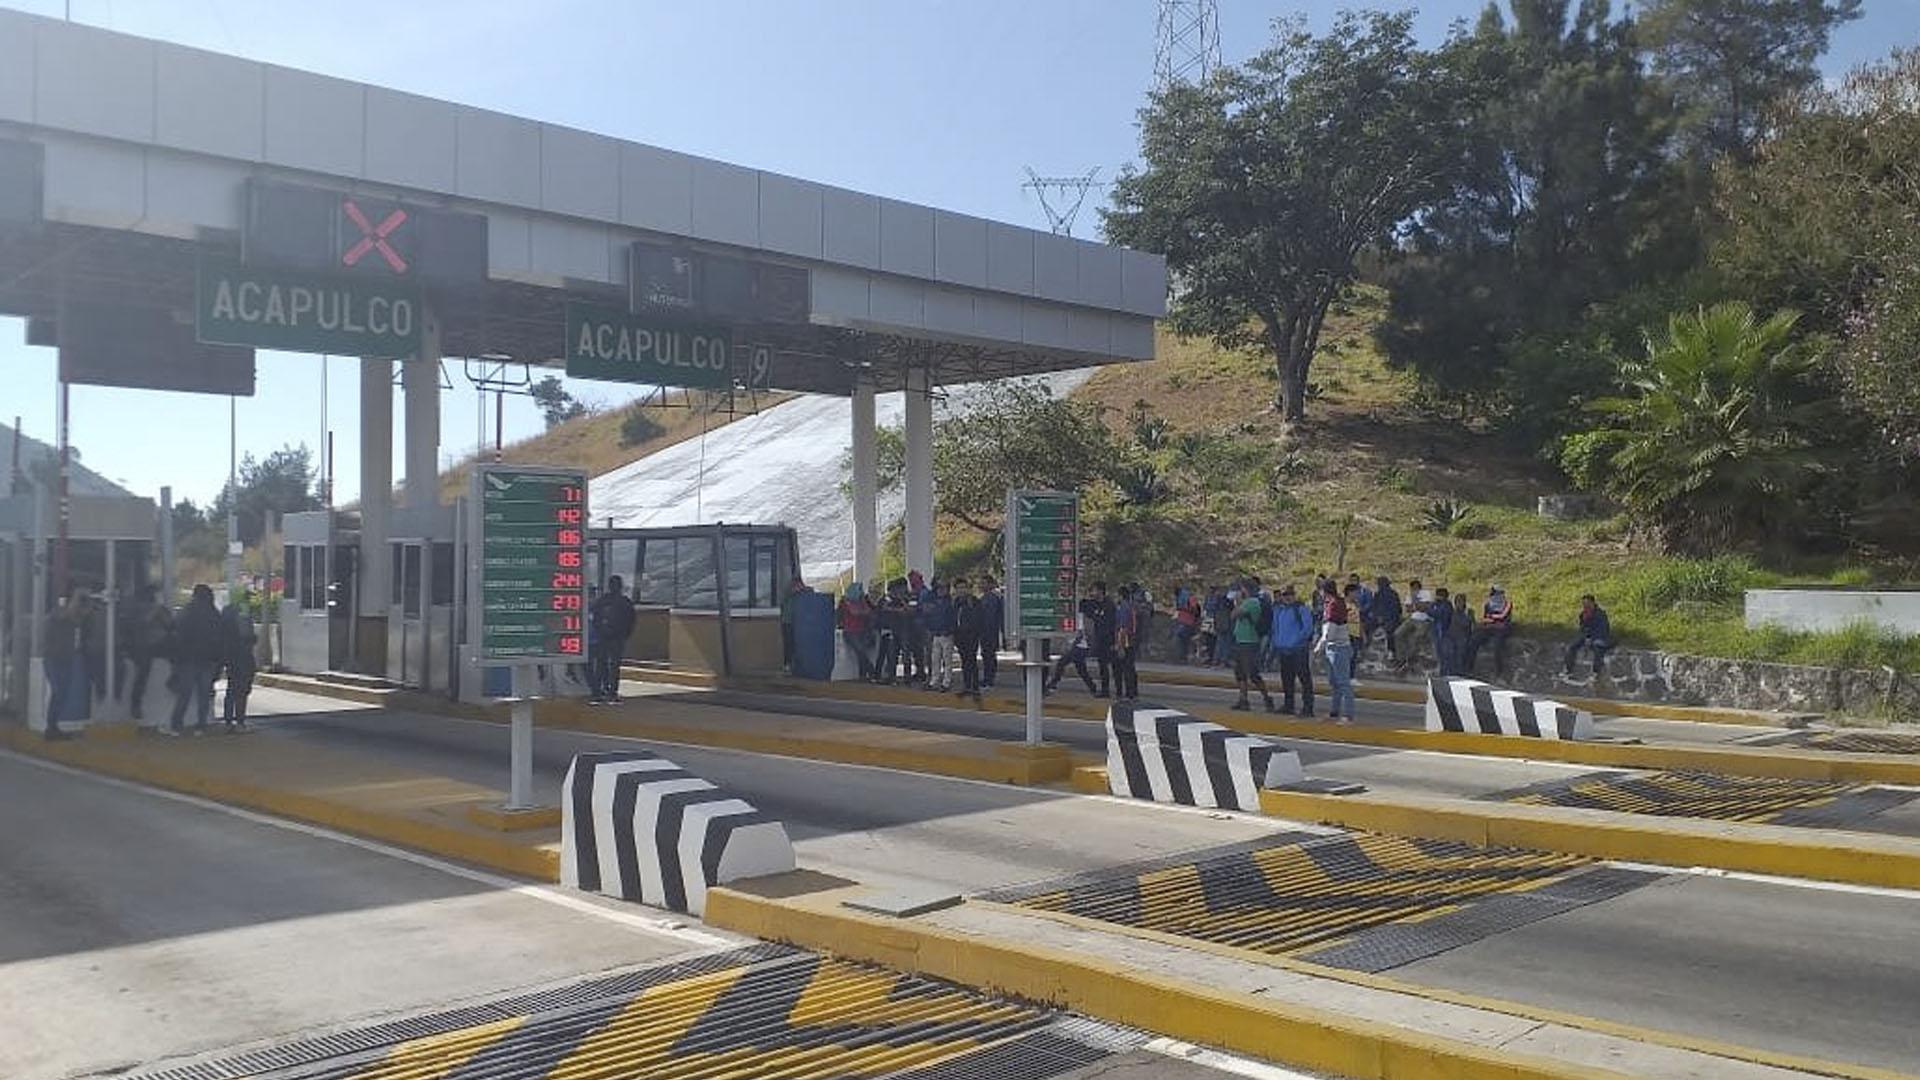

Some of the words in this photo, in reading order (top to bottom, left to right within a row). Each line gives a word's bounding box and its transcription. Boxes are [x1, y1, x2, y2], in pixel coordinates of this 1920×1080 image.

[212, 279, 412, 336] ACAPULCO
[577, 321, 726, 371] ACAPULCO
[752, 348, 769, 385] 9
